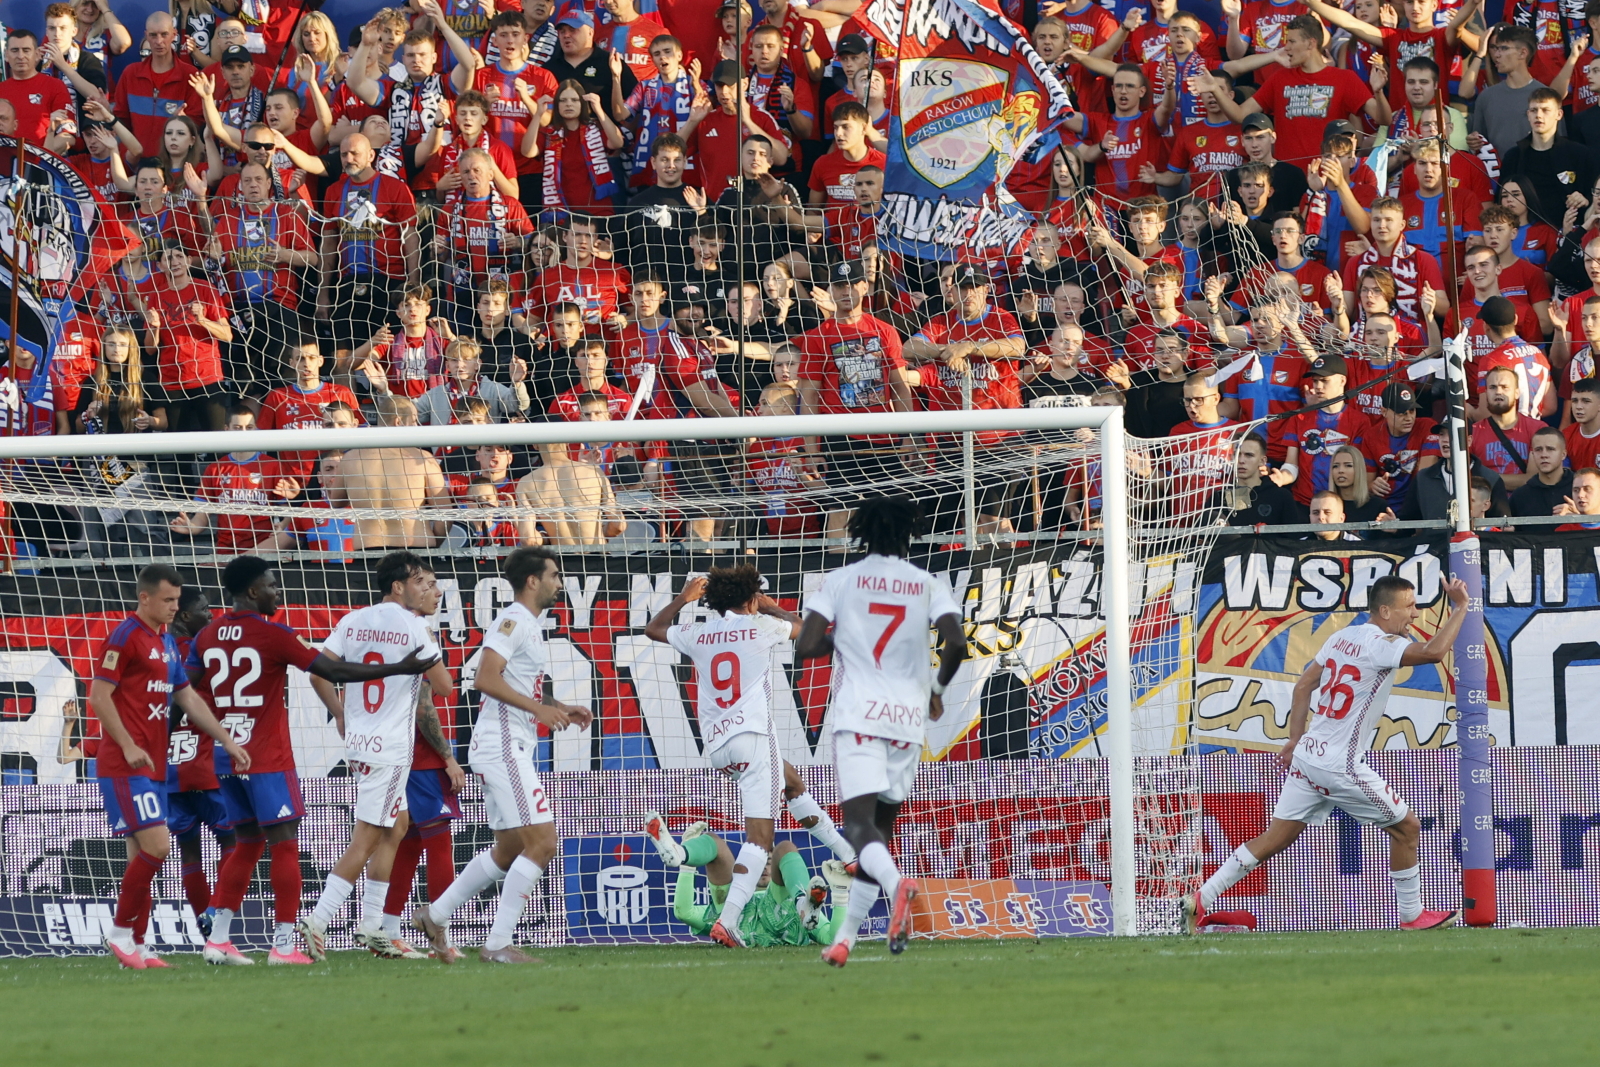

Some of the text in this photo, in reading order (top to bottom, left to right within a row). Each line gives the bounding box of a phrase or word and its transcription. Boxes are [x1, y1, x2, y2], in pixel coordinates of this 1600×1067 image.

[1068, 24, 1095, 35] sztyn
[910, 70, 953, 87] RKS
[924, 93, 974, 121] RAKÓW
[929, 157, 957, 171] 1921
[470, 227, 489, 238] RAK
[1224, 545, 1568, 612] WSPÓNI
[217, 625, 242, 641] OJO
[356, 629, 409, 647] BERNARDO
[696, 628, 758, 646] ANTISTE
[868, 602, 906, 670] 7
[1332, 638, 1362, 657] ANICKI
[203, 647, 264, 709] 22
[363, 651, 386, 715] 8
[710, 651, 742, 709] 9
[1316, 658, 1361, 720] 26
[864, 700, 922, 728] ZARYS
[167, 730, 199, 765] TS
[132, 791, 161, 822] 10
[390, 796, 402, 819] 8
[532, 788, 549, 814] 2
[943, 893, 990, 928] STS
[1004, 893, 1049, 928] STS
[1064, 893, 1110, 928] STS
